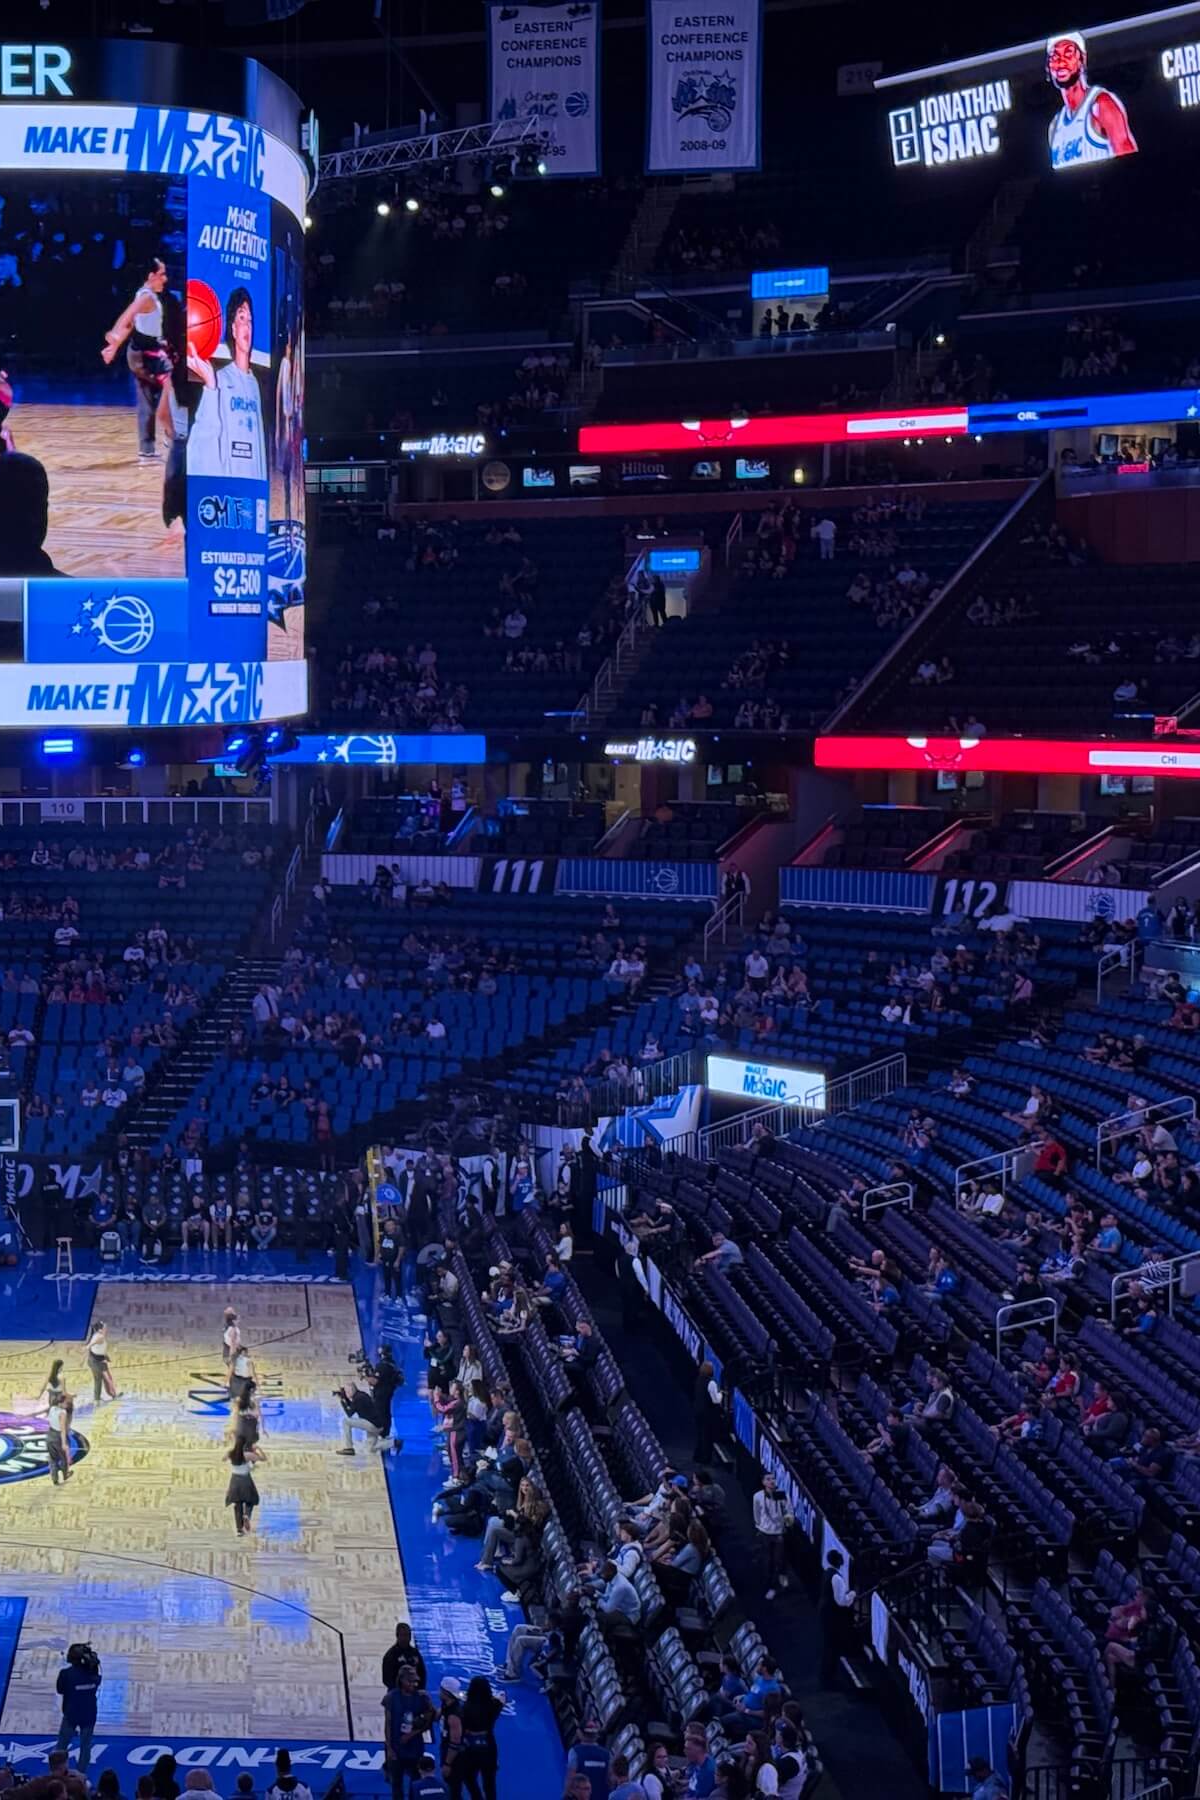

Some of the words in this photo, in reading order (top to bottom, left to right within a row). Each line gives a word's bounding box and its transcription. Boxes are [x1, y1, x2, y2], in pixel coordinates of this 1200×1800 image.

[514, 21, 574, 34] EASTERN
[674, 15, 735, 28] EASTERN
[500, 36, 588, 52] CONFERENCE
[661, 31, 749, 46] CONFERENCE
[506, 55, 583, 70] CHAMPIONS
[665, 49, 744, 64] CHAMPIONS
[1179, 74, 1200, 107] HI
[919, 80, 1012, 129] JONATHAN
[24, 126, 107, 154] MAKE
[112, 127, 132, 155] IT
[680, 140, 727, 152] 2008-09
[922, 116, 1000, 167] ISAAC
[898, 419, 916, 428] CHI
[1017, 411, 1039, 421] ORL
[621, 461, 665, 474] Hilton
[214, 566, 261, 599] $2,500
[27, 685, 109, 710] MAKE
[113, 685, 134, 710] IT
[1161, 754, 1178, 765] CHI
[50, 802, 75, 816] 110
[492, 859, 545, 894] 111
[942, 879, 998, 918] 112
[126, 1744, 387, 1771] RLANDO
